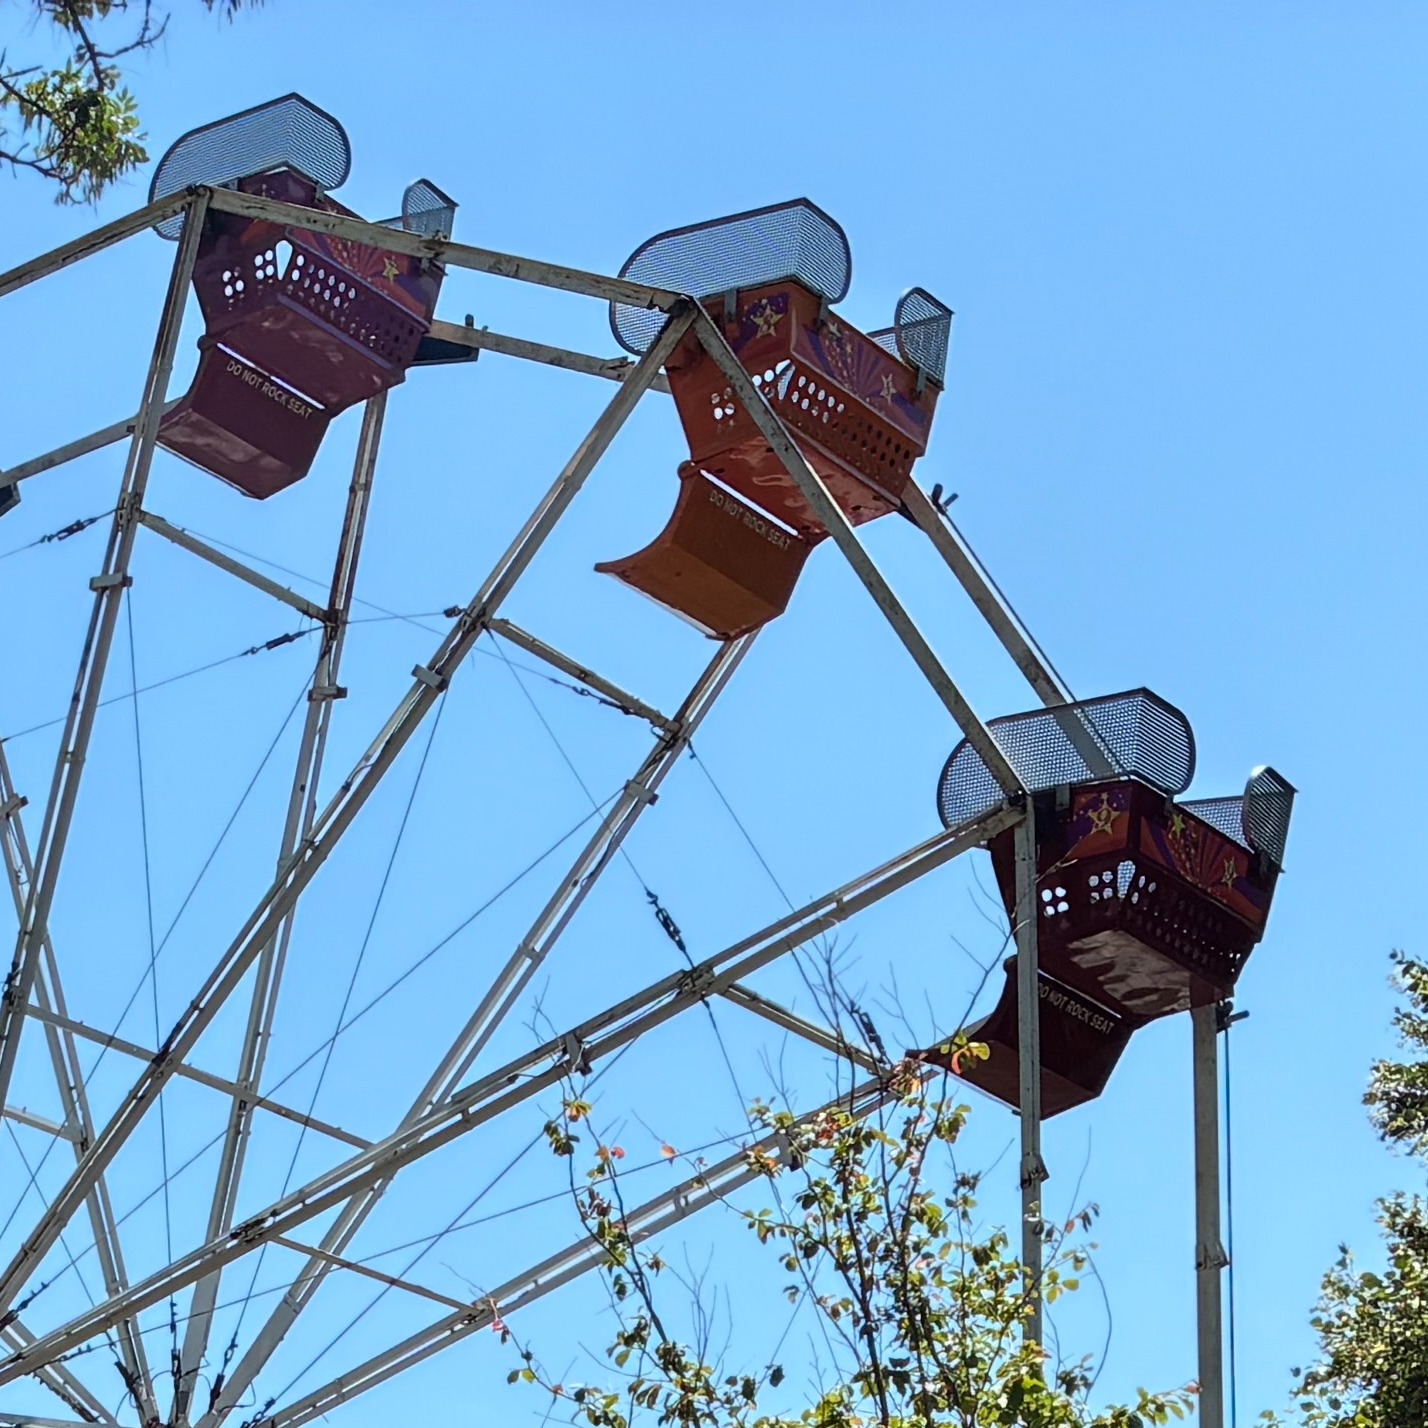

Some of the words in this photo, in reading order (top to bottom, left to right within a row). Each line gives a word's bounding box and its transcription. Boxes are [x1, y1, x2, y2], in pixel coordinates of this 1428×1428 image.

[226, 361, 242, 376] DO
[242, 369, 263, 389] NOT
[261, 382, 289, 406] ROCK
[287, 398, 313, 420] SEAT
[709, 489, 724, 506] DO
[767, 528, 791, 550] SEAT
[1048, 989, 1068, 1008] NOT
[1065, 1000, 1093, 1024] ROCK
[1090, 1014, 1115, 1034] SEAT
